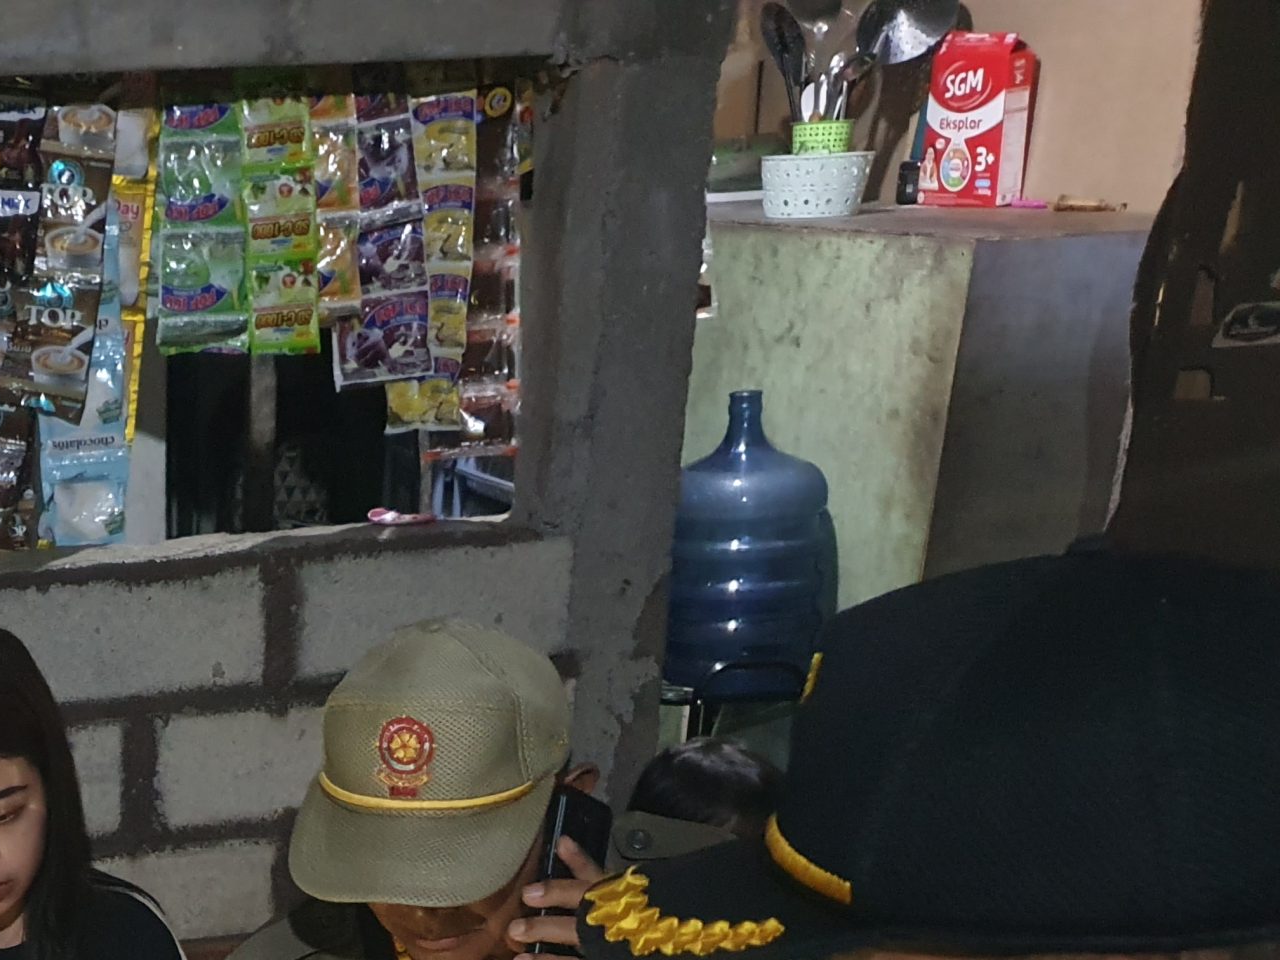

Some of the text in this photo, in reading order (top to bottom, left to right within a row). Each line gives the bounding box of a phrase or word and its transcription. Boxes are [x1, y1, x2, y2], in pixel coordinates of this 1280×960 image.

[944, 67, 984, 98] SGM
[939, 116, 983, 132] Eksplor
[974, 146, 995, 172] 3+
[24, 305, 83, 327] TOP
